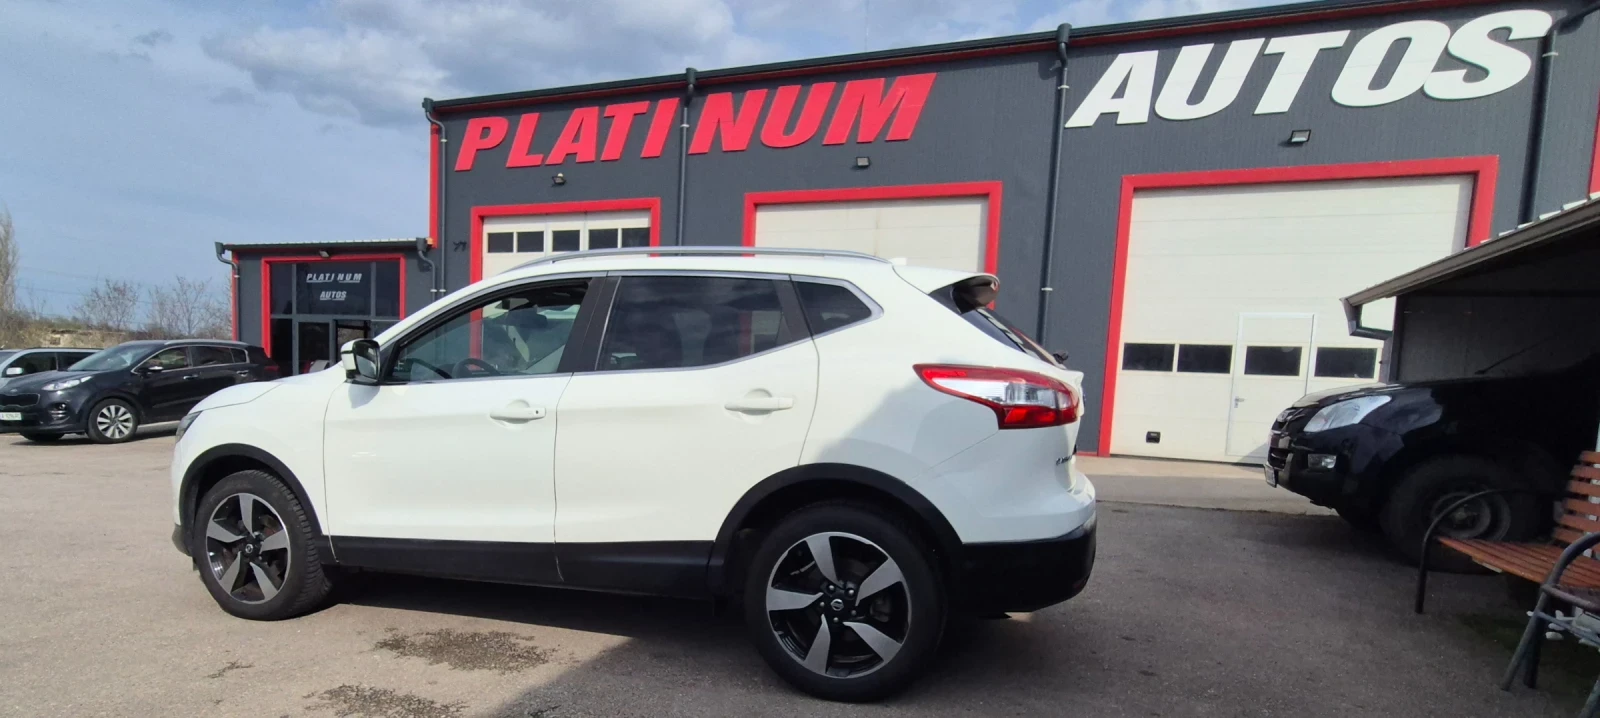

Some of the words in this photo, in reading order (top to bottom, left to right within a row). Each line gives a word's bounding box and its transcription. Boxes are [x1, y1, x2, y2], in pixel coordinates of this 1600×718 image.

[455, 73, 936, 171] PLATINUM
[1065, 10, 1552, 128] AUTOS
[320, 290, 347, 300] AUTOS
